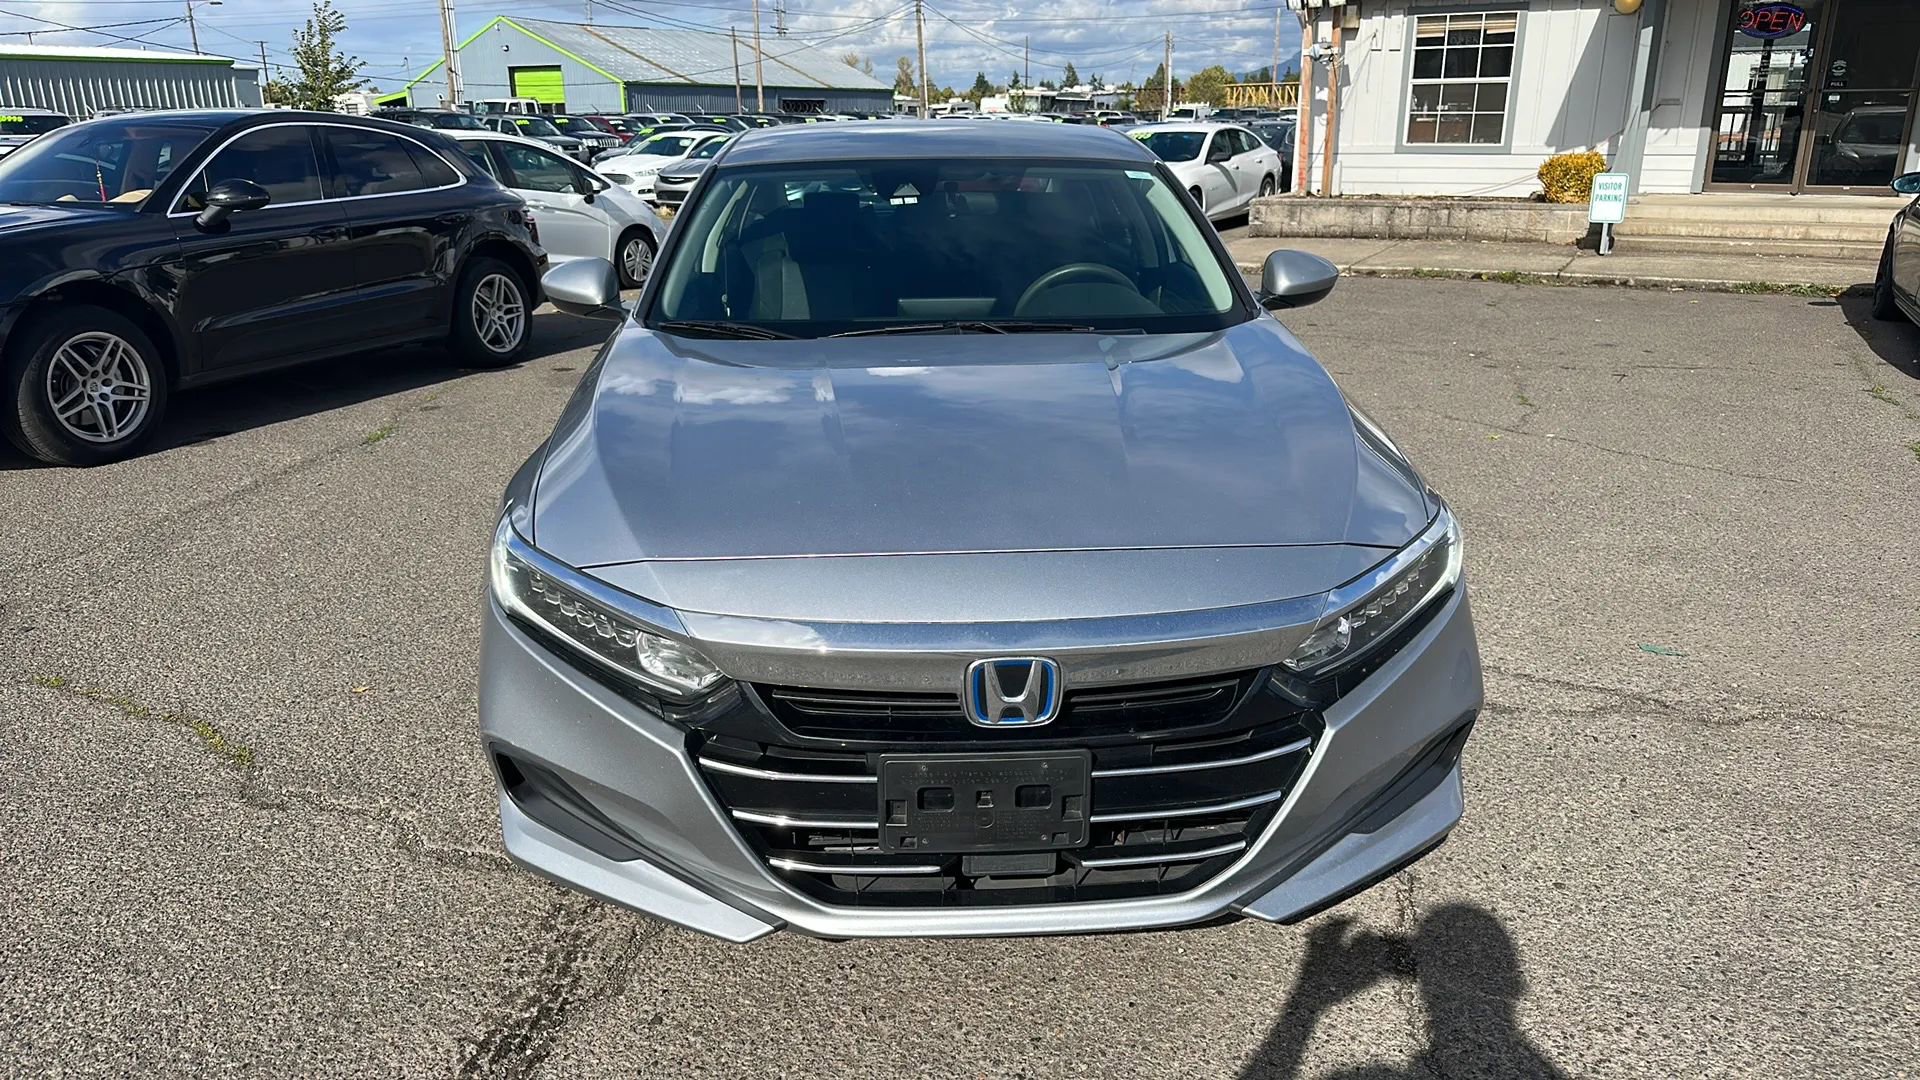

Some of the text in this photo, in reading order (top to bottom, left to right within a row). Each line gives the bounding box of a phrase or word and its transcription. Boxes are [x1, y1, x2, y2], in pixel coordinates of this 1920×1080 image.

[1739, 10, 1805, 32] OPEN
[1599, 182, 1623, 191] VISITOR
[1595, 193, 1623, 202] PARKING
